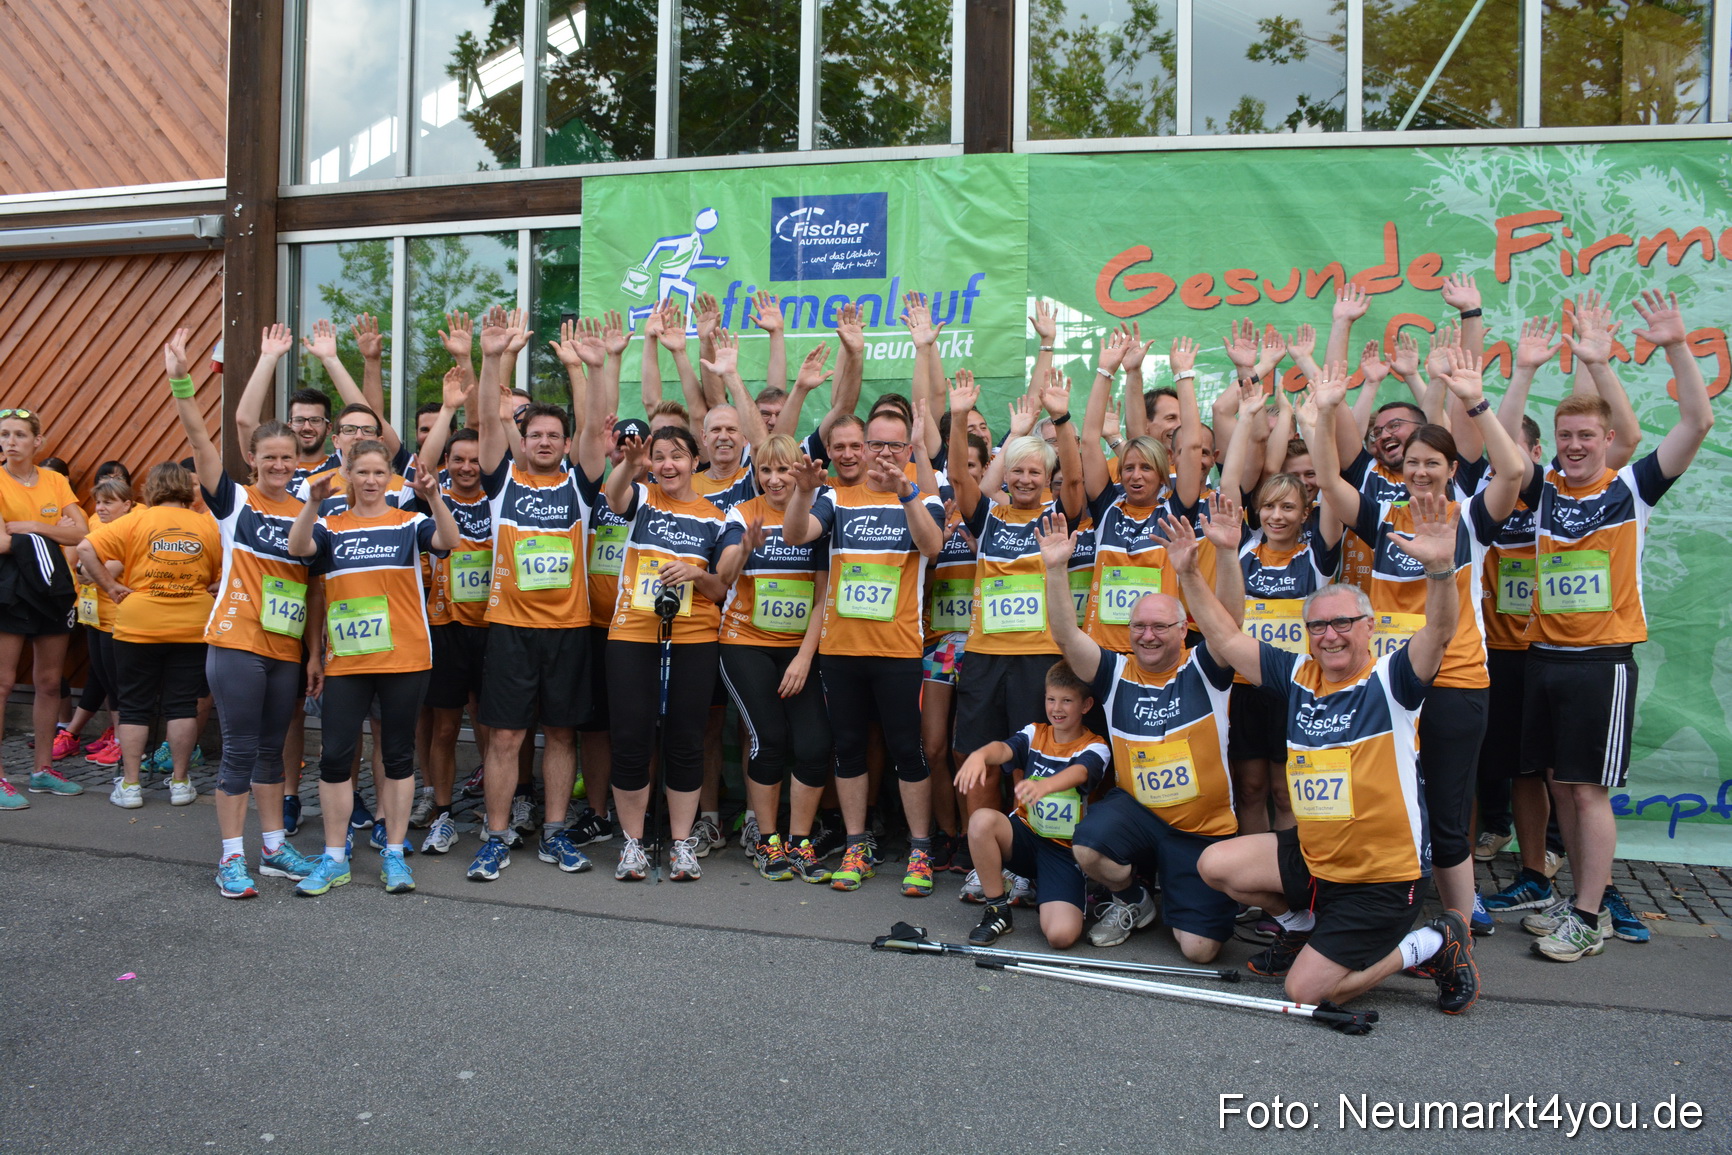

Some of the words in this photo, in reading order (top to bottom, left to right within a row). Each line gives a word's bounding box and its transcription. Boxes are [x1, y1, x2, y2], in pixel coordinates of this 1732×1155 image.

[792, 219, 869, 237] Fischer
[799, 236, 863, 246] AUTOMOBILE
[1096, 221, 1447, 318] Gesunde
[863, 331, 974, 360] neumrkt
[656, 526, 705, 543] Fischer
[853, 524, 907, 536] Fischer
[152, 539, 187, 554] plank
[345, 544, 399, 556] Fischer
[661, 536, 701, 547] AUTOMOBILE
[764, 544, 813, 556] Fischer
[522, 556, 569, 575] 1625
[457, 570, 491, 587] 164
[1545, 574, 1600, 597] 1621
[641, 578, 685, 601] 161
[844, 584, 893, 605] 1637
[1105, 589, 1153, 608] 162
[83, 601, 92, 615] 75
[269, 598, 306, 623] 1426
[761, 599, 806, 619] 1636
[988, 596, 1039, 617] 1629
[335, 618, 383, 640] 1427
[1247, 623, 1302, 642] 1646
[1139, 697, 1181, 720] Fiscer
[1137, 765, 1190, 791] 1628
[1294, 777, 1344, 801] 1627
